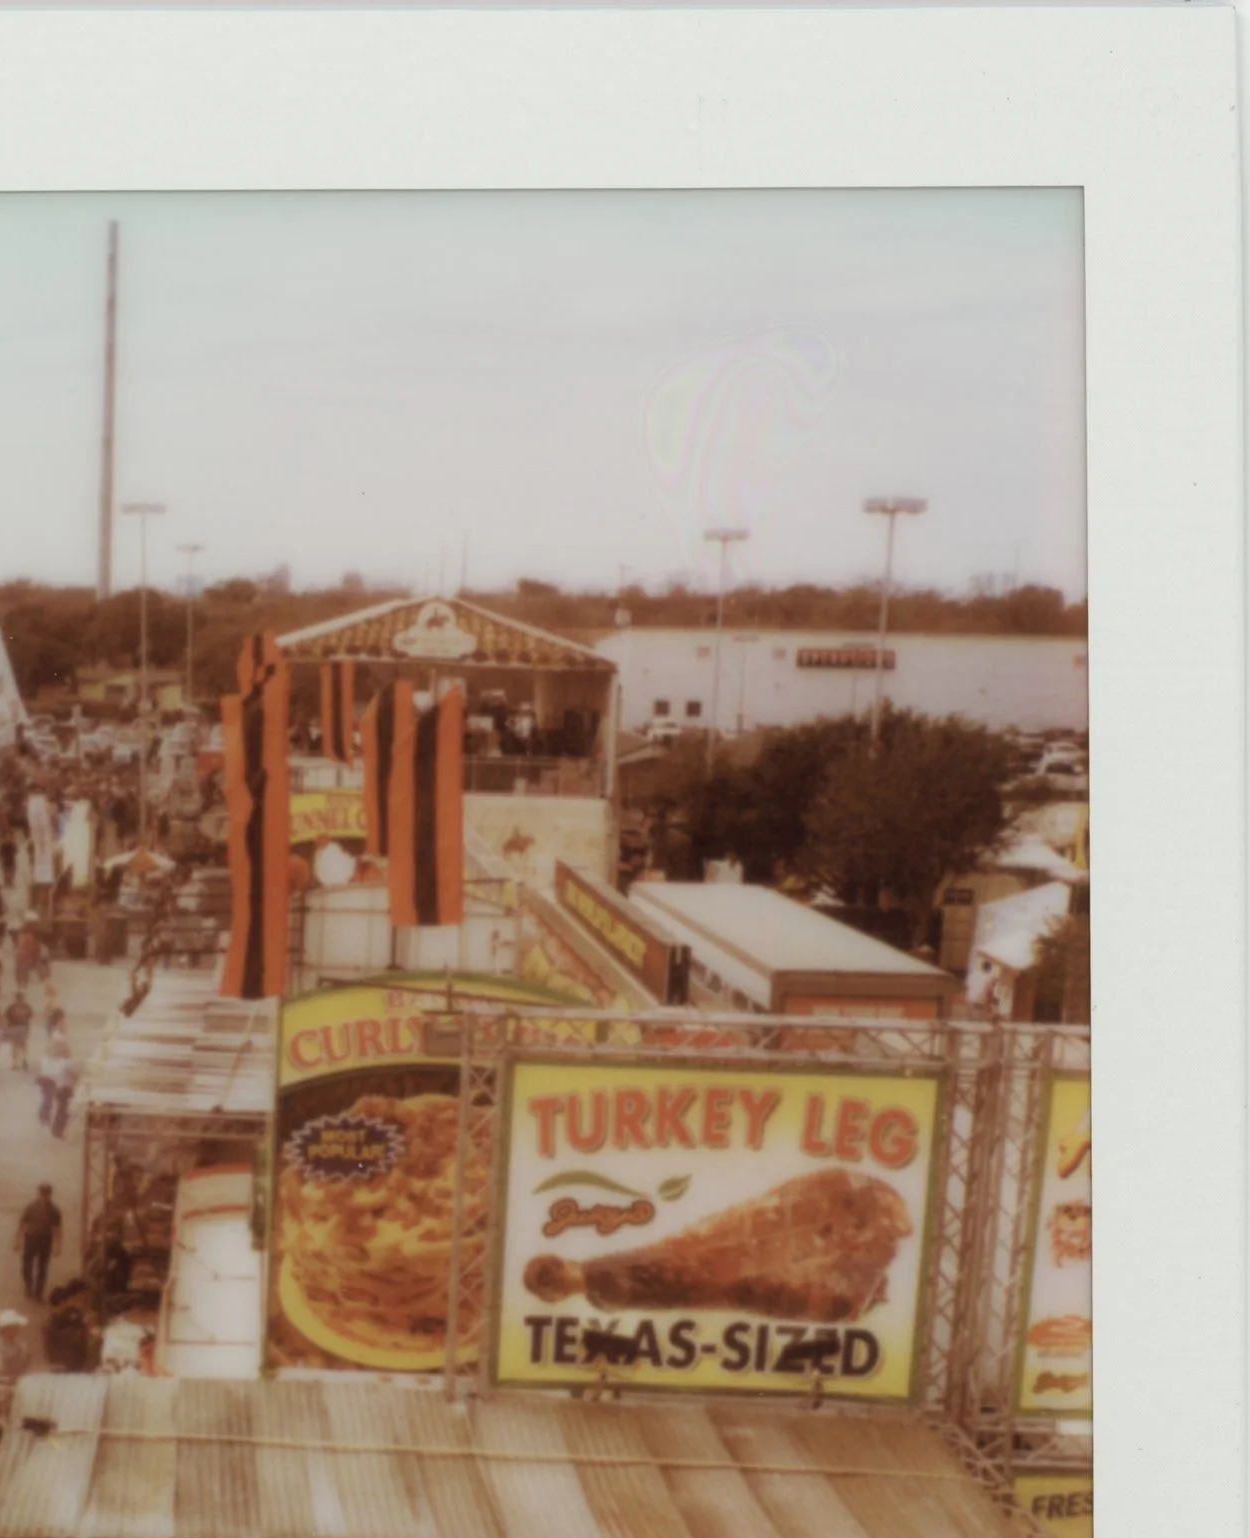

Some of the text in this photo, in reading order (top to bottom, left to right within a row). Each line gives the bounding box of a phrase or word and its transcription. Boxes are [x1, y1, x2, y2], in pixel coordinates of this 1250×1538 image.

[527, 1085, 919, 1169] TURKEY LEG
[524, 1315, 882, 1378] TEXAS-SIZED
